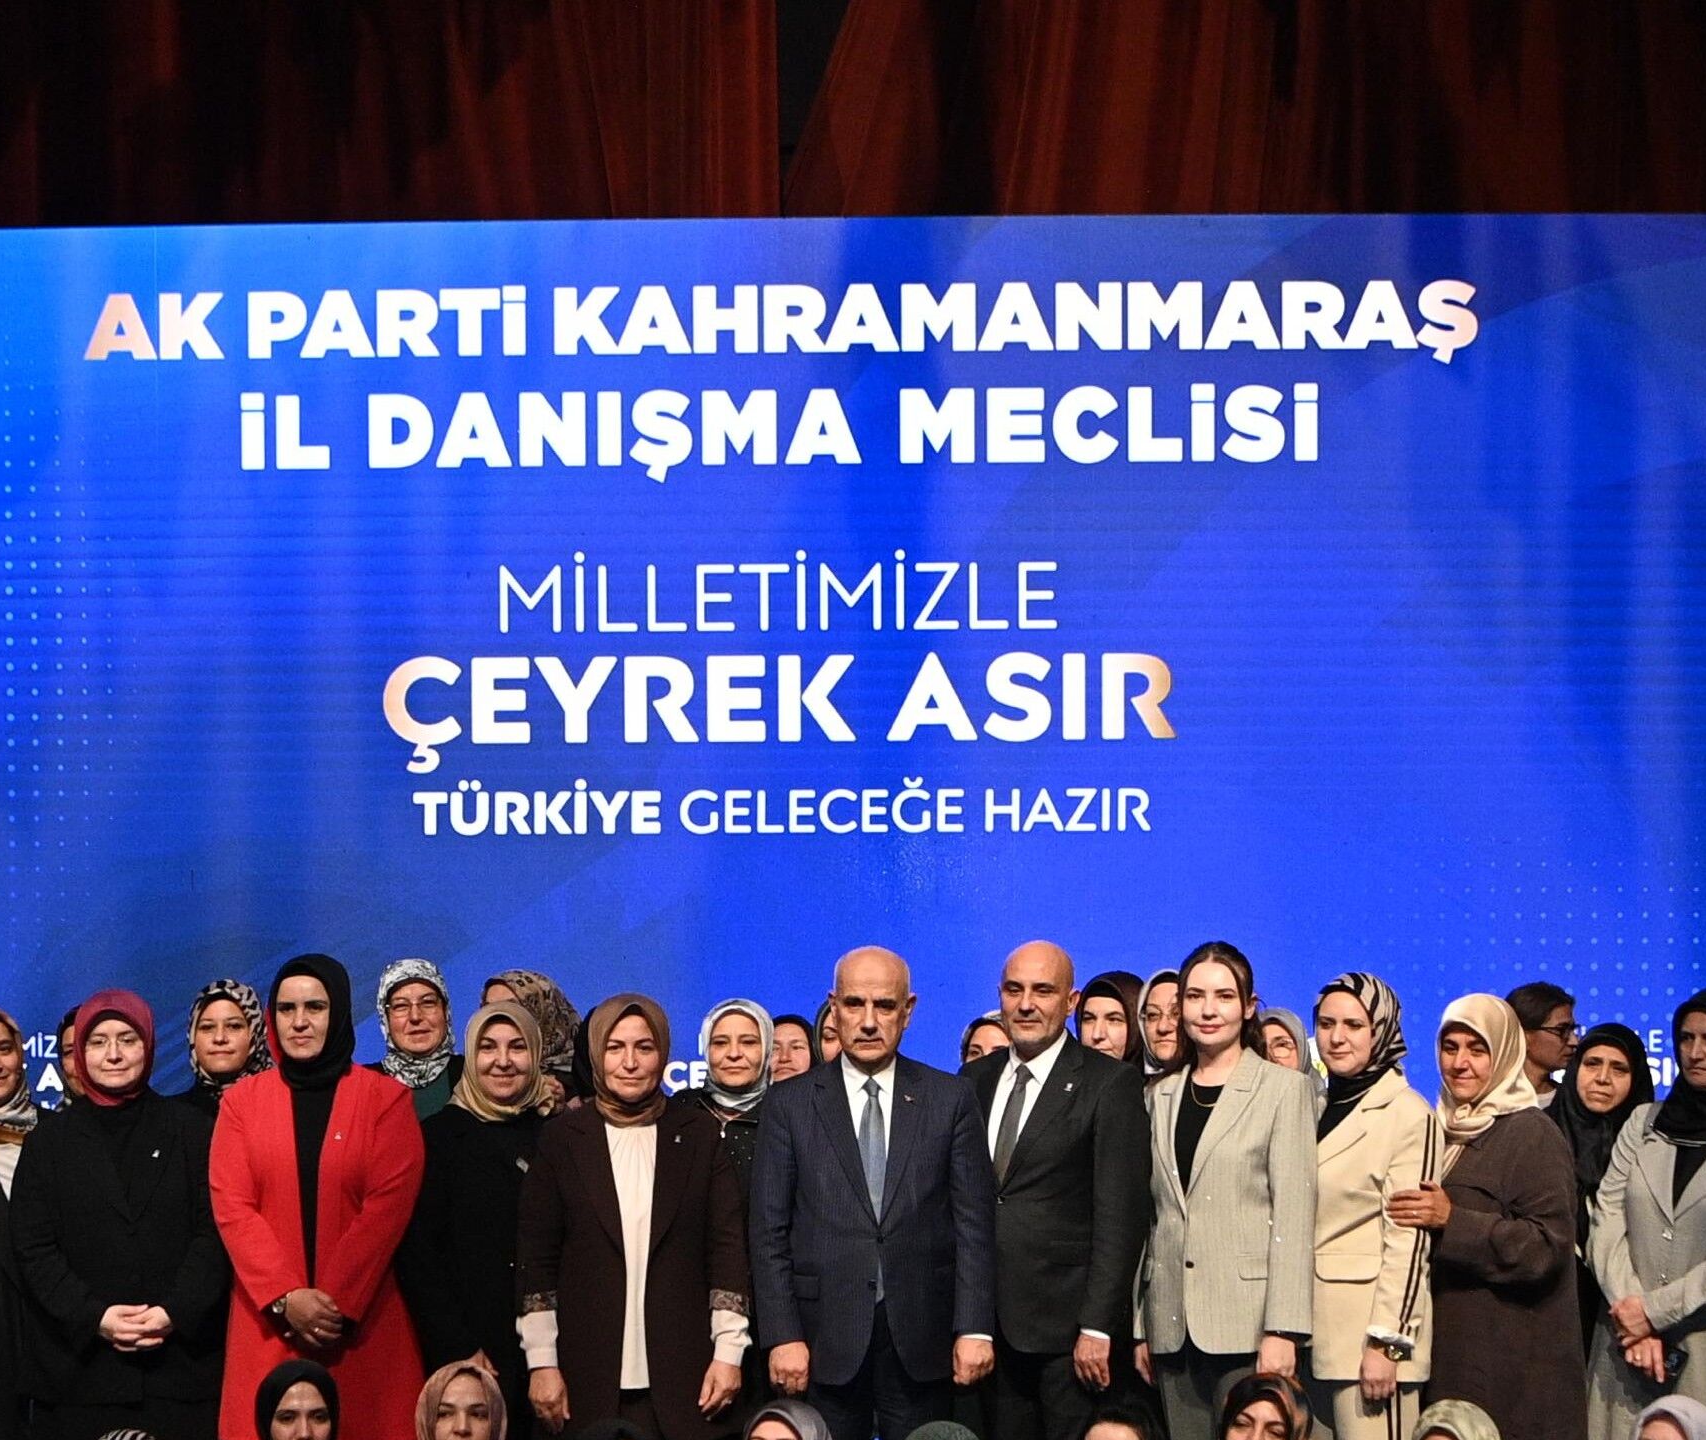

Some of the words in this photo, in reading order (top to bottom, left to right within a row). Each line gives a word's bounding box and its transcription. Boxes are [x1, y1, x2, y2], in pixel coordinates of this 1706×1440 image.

[84, 290, 225, 361] AK
[247, 284, 527, 359] PARTİ
[552, 279, 1479, 364] KAHRAMANMARAŞ
[240, 392, 331, 470] İL
[367, 388, 862, 483] DANIŞMA
[899, 382, 1319, 464] MECLİSİ
[499, 549, 1059, 634] MİLLETİMİZLE
[381, 652, 856, 774] ÇEYREK
[885, 650, 1177, 743] ASIR
[410, 778, 662, 836] TÜRKİYE
[679, 776, 966, 835] GELECEĞE
[984, 786, 1152, 833] HAZIR
